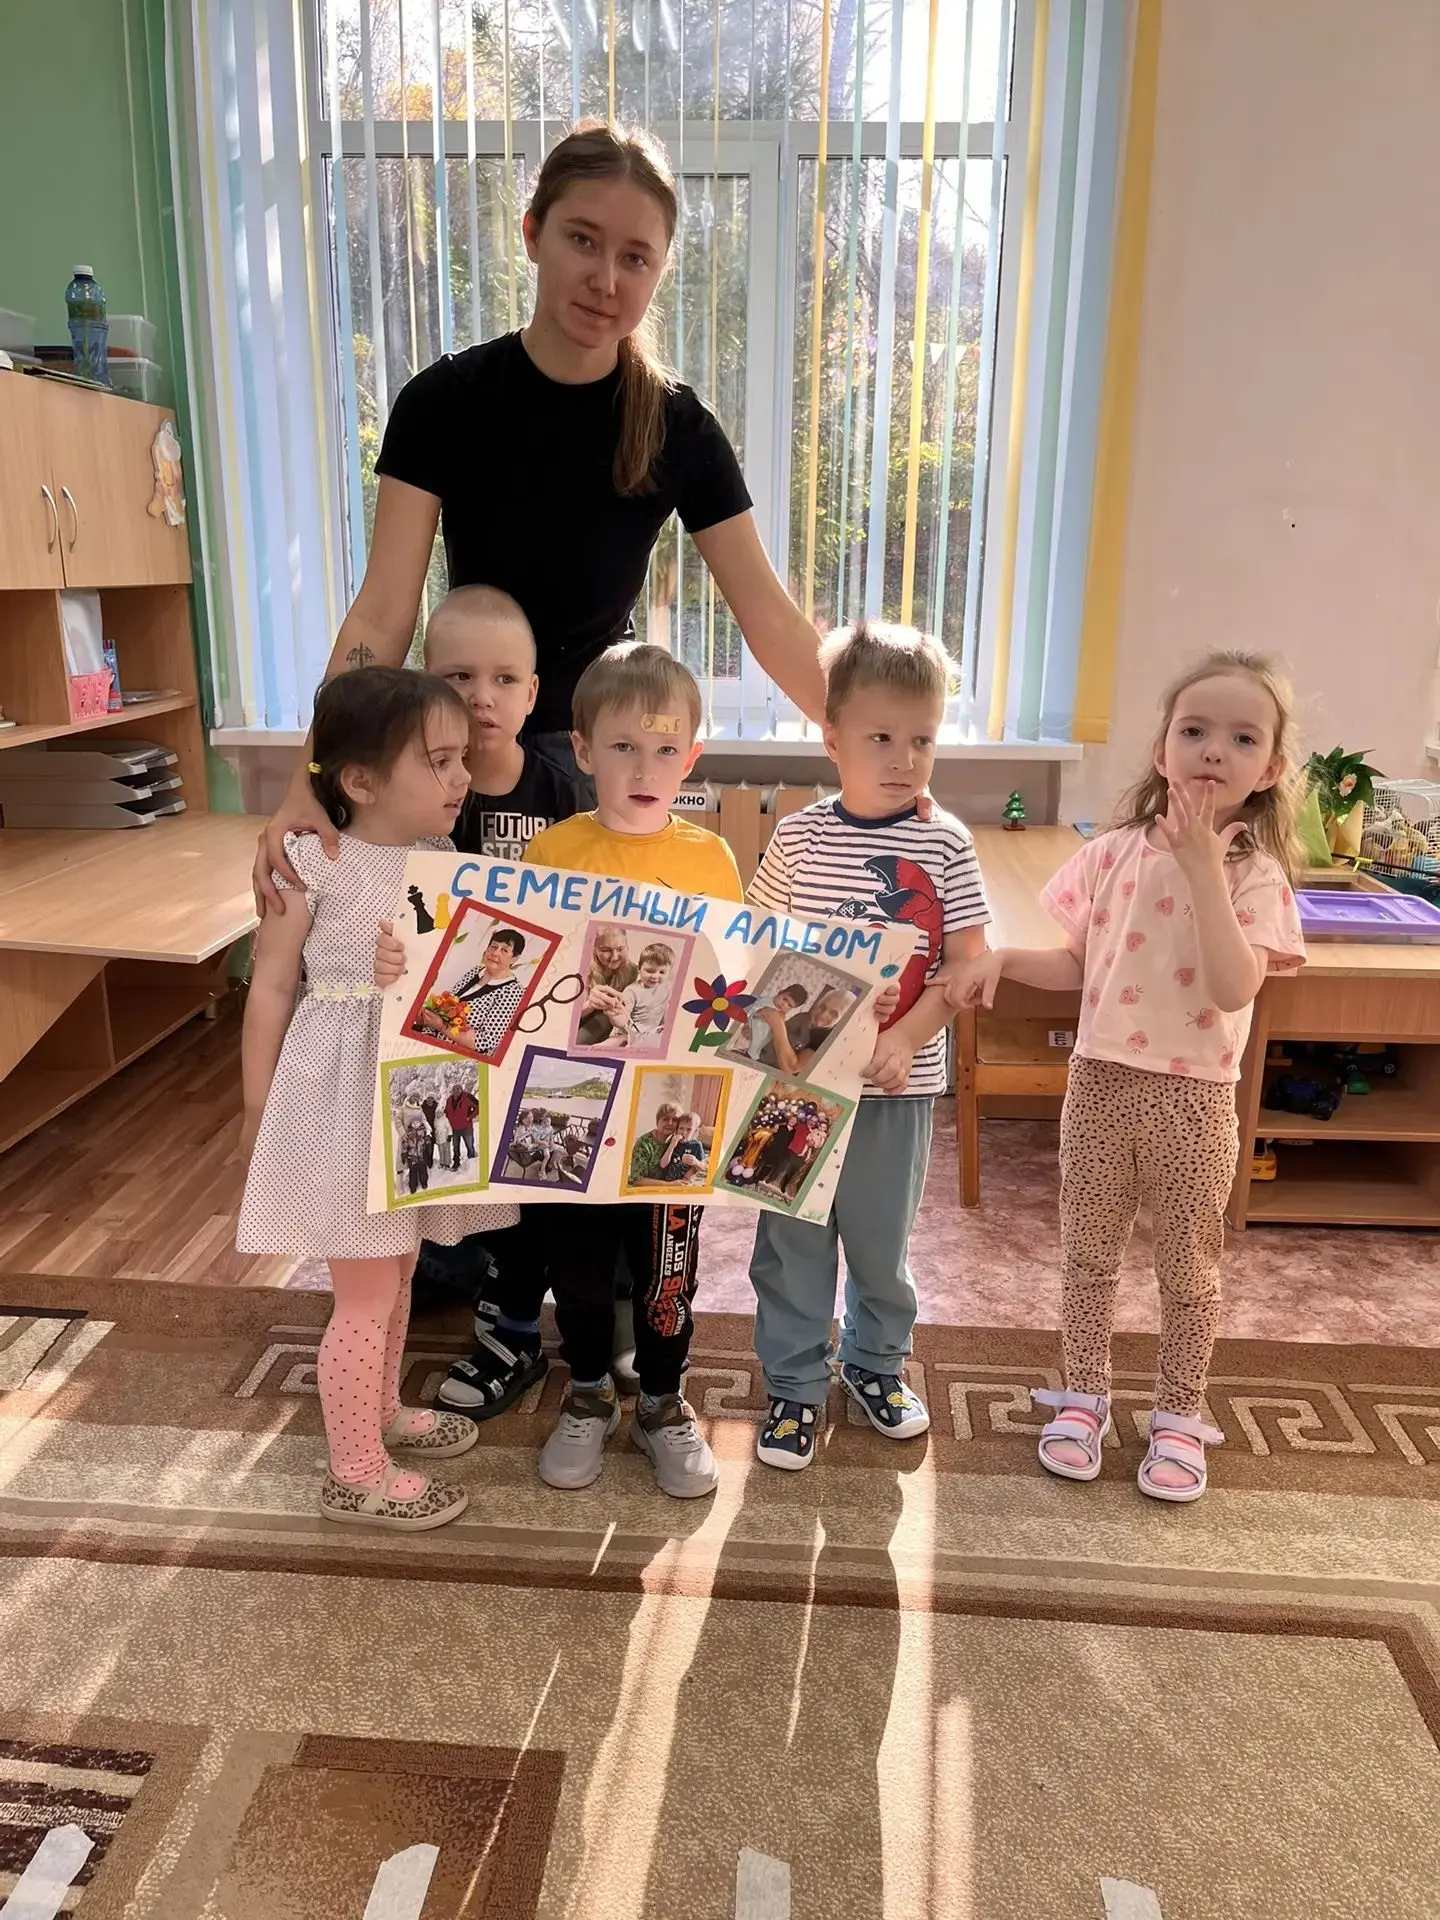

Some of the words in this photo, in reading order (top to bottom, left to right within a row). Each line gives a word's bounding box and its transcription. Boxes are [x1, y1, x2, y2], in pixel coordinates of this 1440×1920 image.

[482, 842, 528, 861] STR
[451, 862, 708, 933] СЕМЕЙНЫЙ
[724, 910, 882, 965] АЛЬБОМ
[664, 1233, 674, 1276] ANGELES
[674, 1240, 685, 1272] LOS
